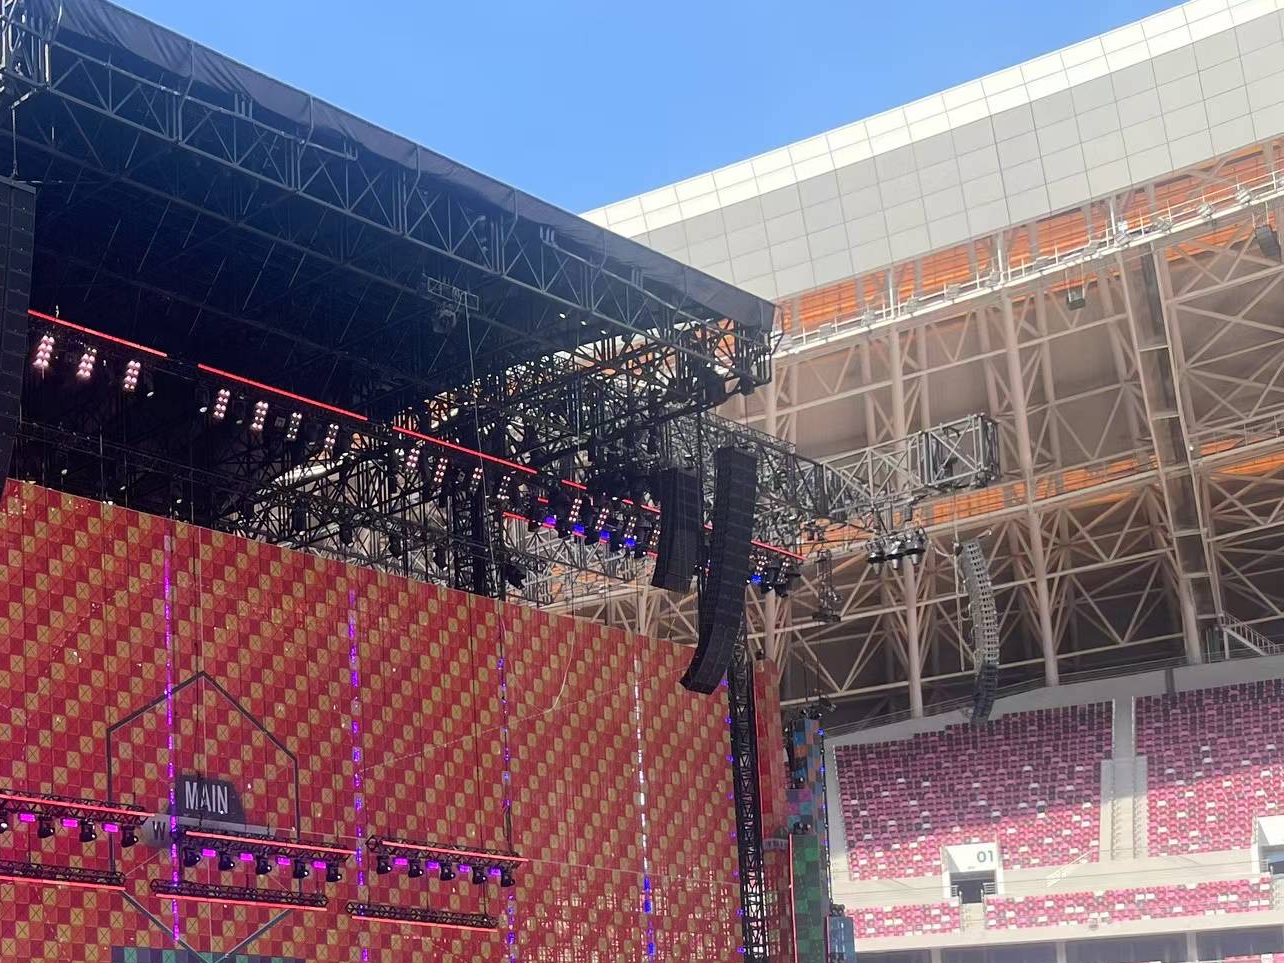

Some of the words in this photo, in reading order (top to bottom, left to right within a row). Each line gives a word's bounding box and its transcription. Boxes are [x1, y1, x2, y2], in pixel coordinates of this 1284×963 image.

[185, 781, 228, 814] MAIN
[152, 820, 166, 841] W
[976, 850, 994, 864] 01
